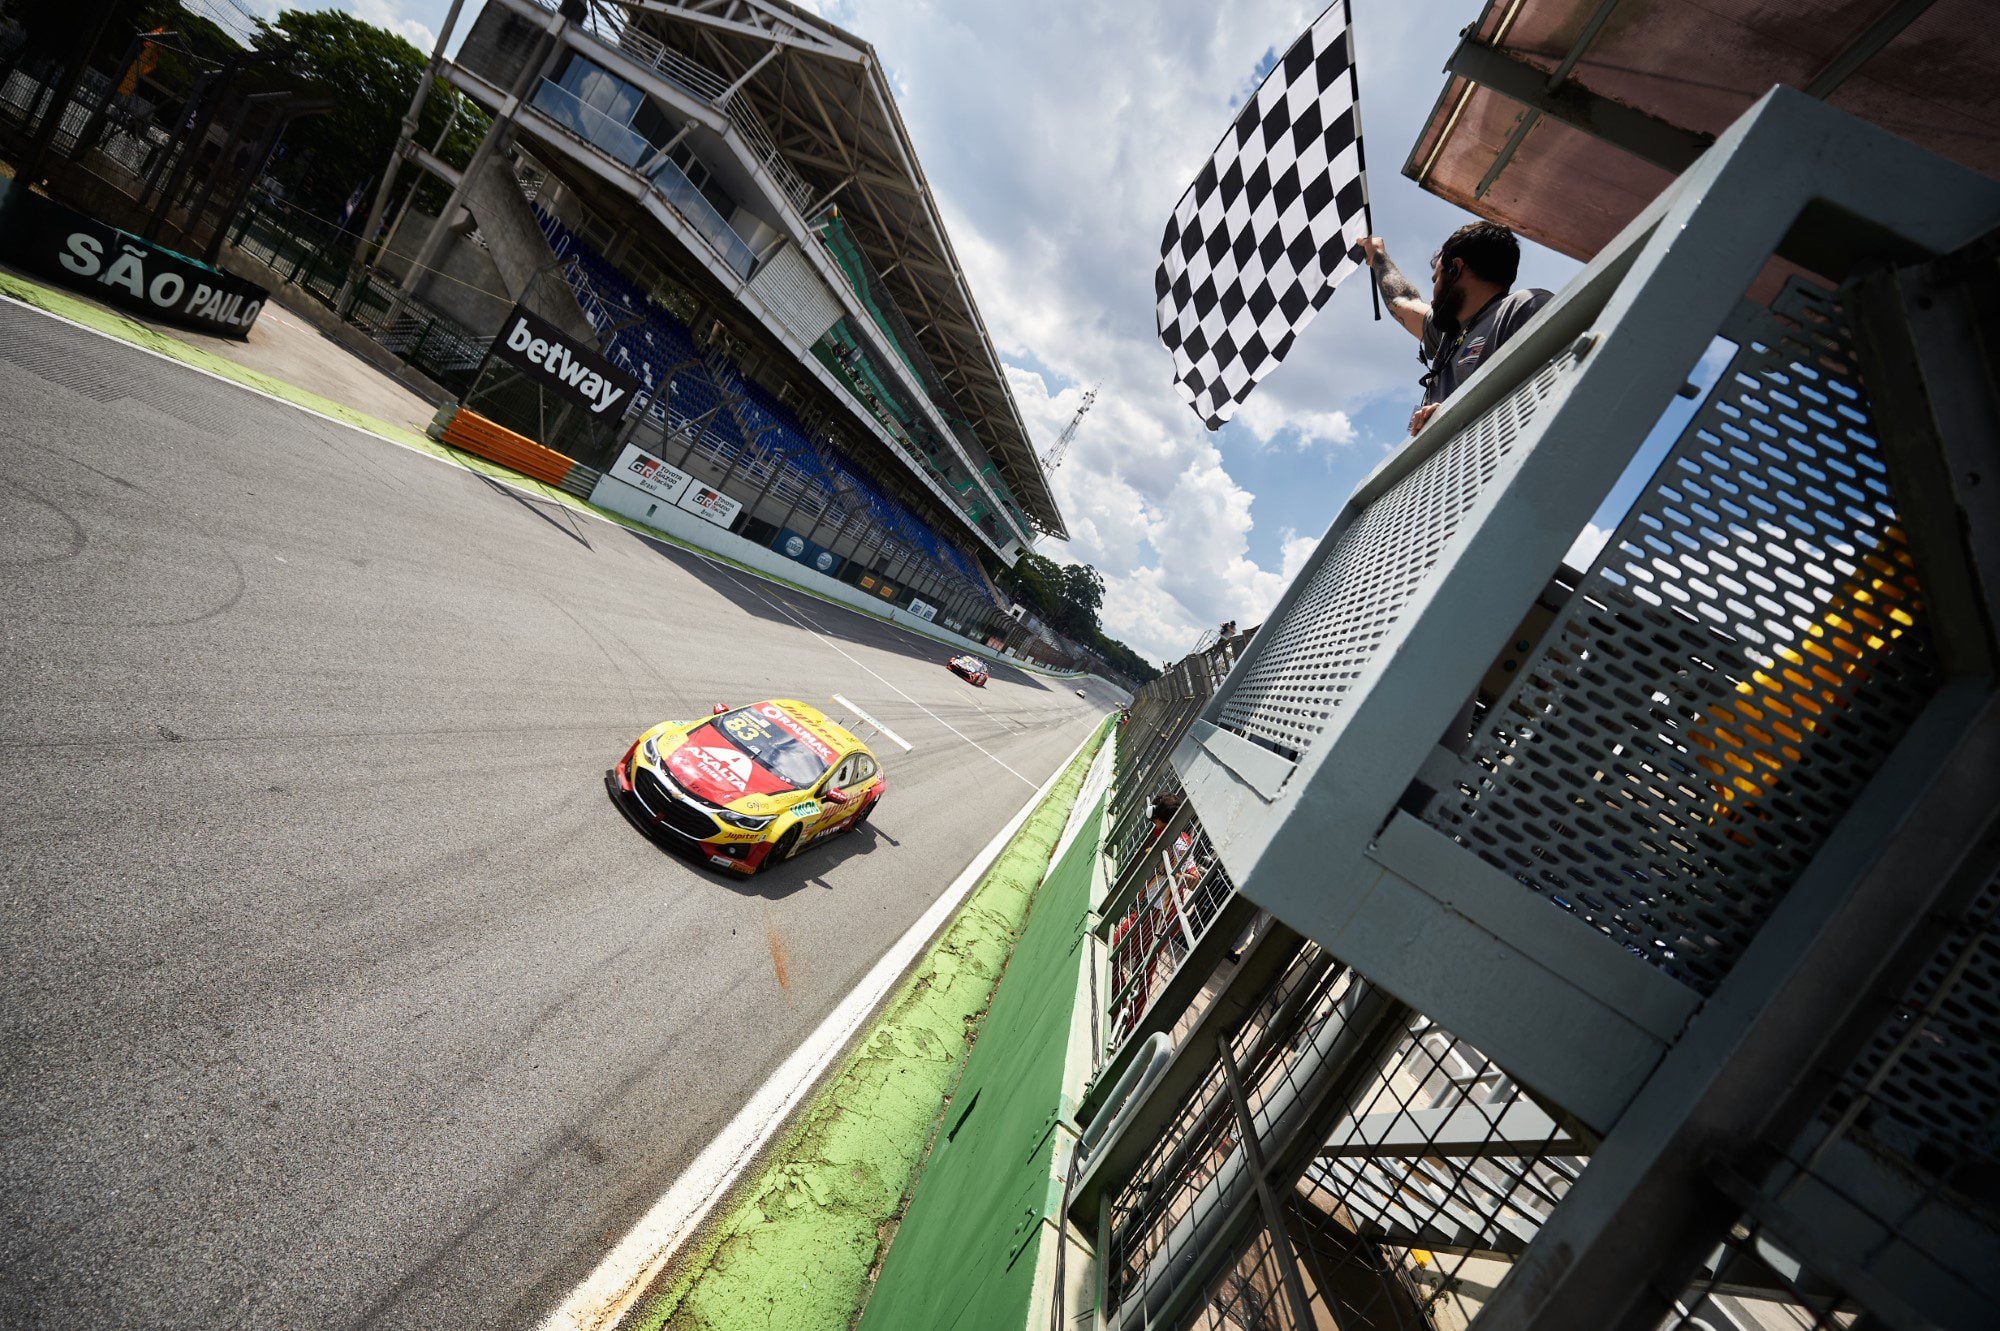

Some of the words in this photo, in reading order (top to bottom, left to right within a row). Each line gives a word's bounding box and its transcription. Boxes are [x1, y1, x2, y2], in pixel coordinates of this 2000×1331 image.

[58, 232, 185, 308] SÃO
[184, 283, 260, 328] PAULO
[506, 316, 625, 413] betway
[629, 461, 655, 478] GR
[661, 466, 683, 481] TOYOTA
[640, 479, 657, 491] Brasil
[652, 476, 673, 490] Racing
[656, 471, 677, 485] GAZOO
[694, 494, 713, 508] GR
[725, 717, 759, 741] 83
[779, 715, 833, 758] RAUMAK
[683, 746, 747, 793] AXALTA
[724, 832, 759, 841] Jupiter
